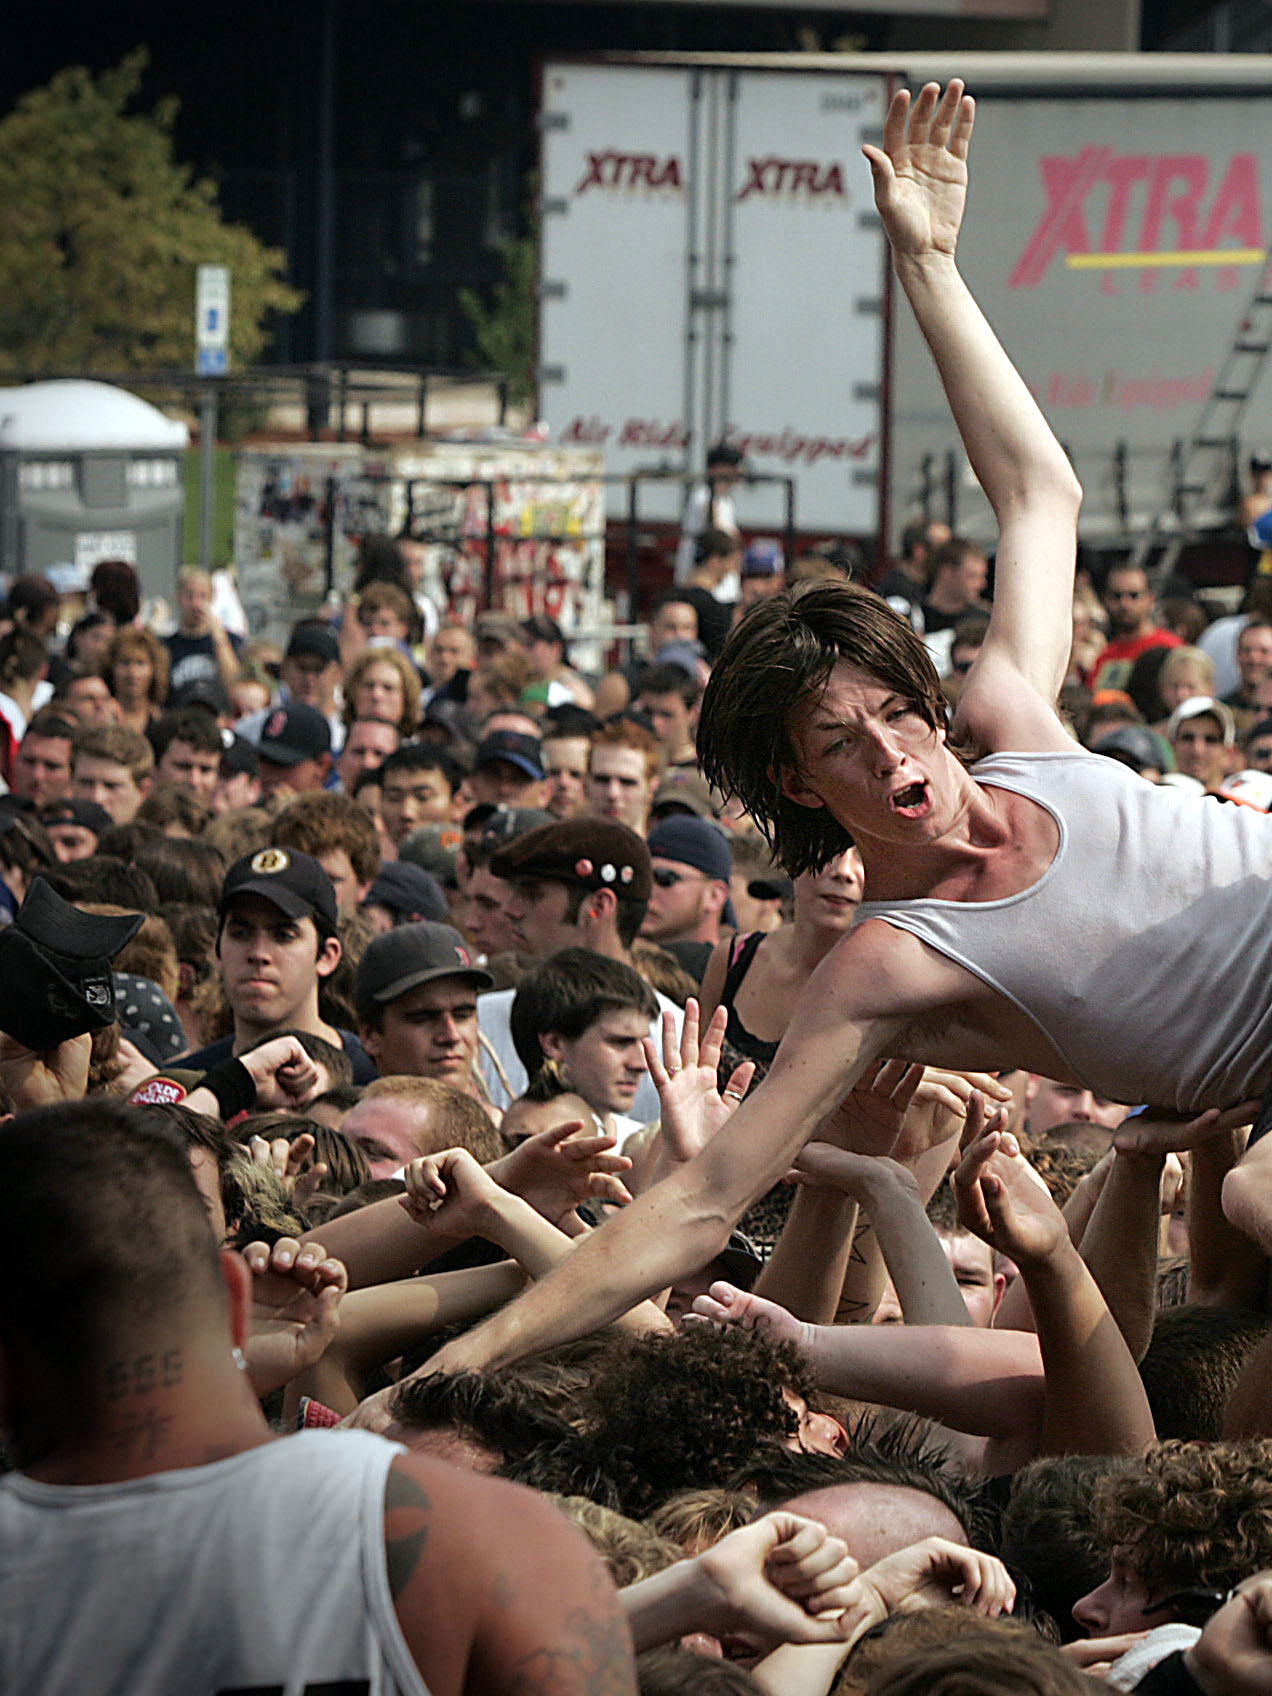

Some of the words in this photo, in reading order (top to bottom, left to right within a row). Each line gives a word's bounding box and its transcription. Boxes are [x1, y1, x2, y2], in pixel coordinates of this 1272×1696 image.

[576, 151, 681, 194] XTRA
[737, 157, 845, 199] XTRA
[1006, 143, 1265, 288] XTRA
